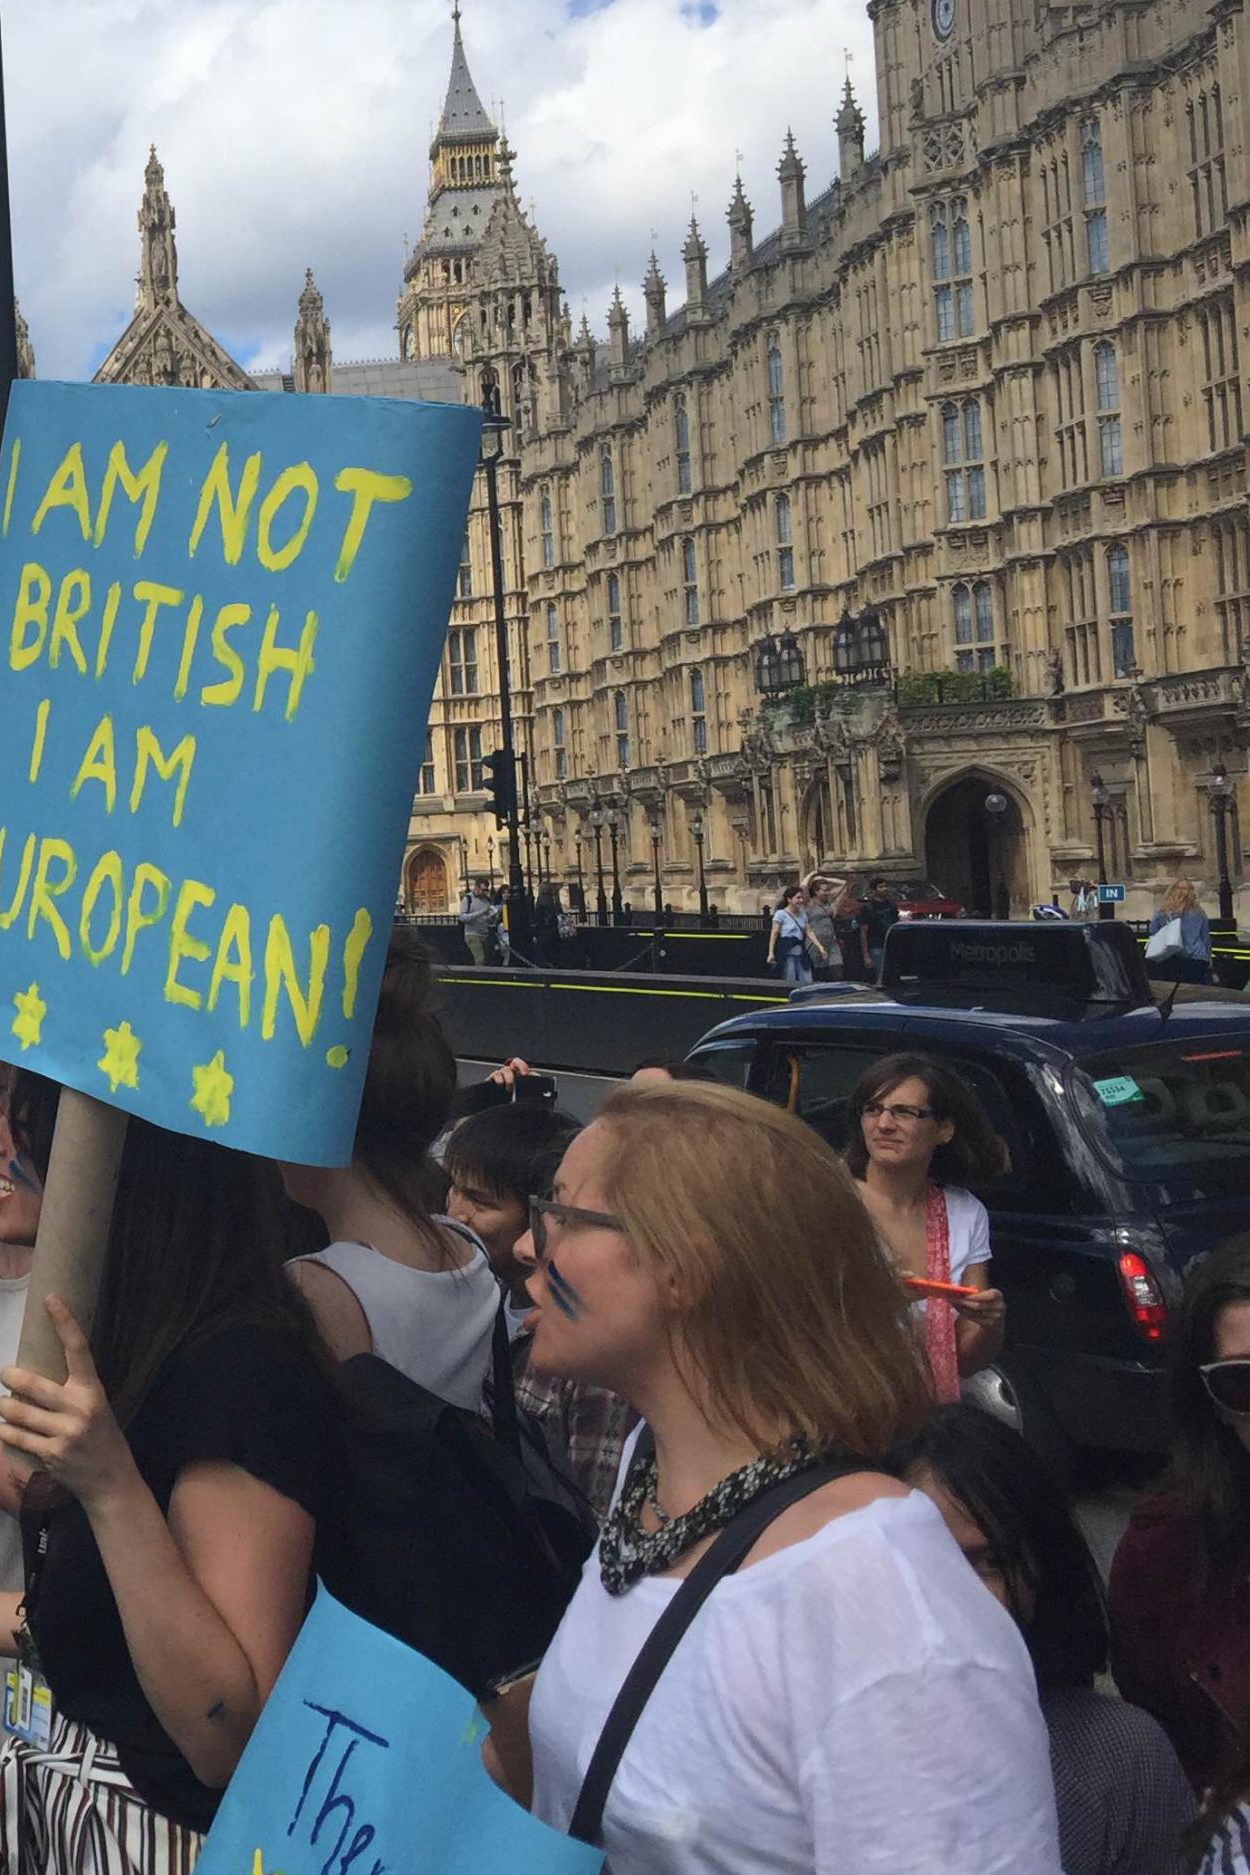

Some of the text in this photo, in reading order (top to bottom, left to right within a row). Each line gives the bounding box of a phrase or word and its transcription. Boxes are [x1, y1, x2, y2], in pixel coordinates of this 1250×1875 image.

[2, 438, 413, 583] I AM NOT
[9, 562, 318, 723] BRITISH
[29, 699, 197, 828] I AM
[1106, 888, 1119, 899] IN
